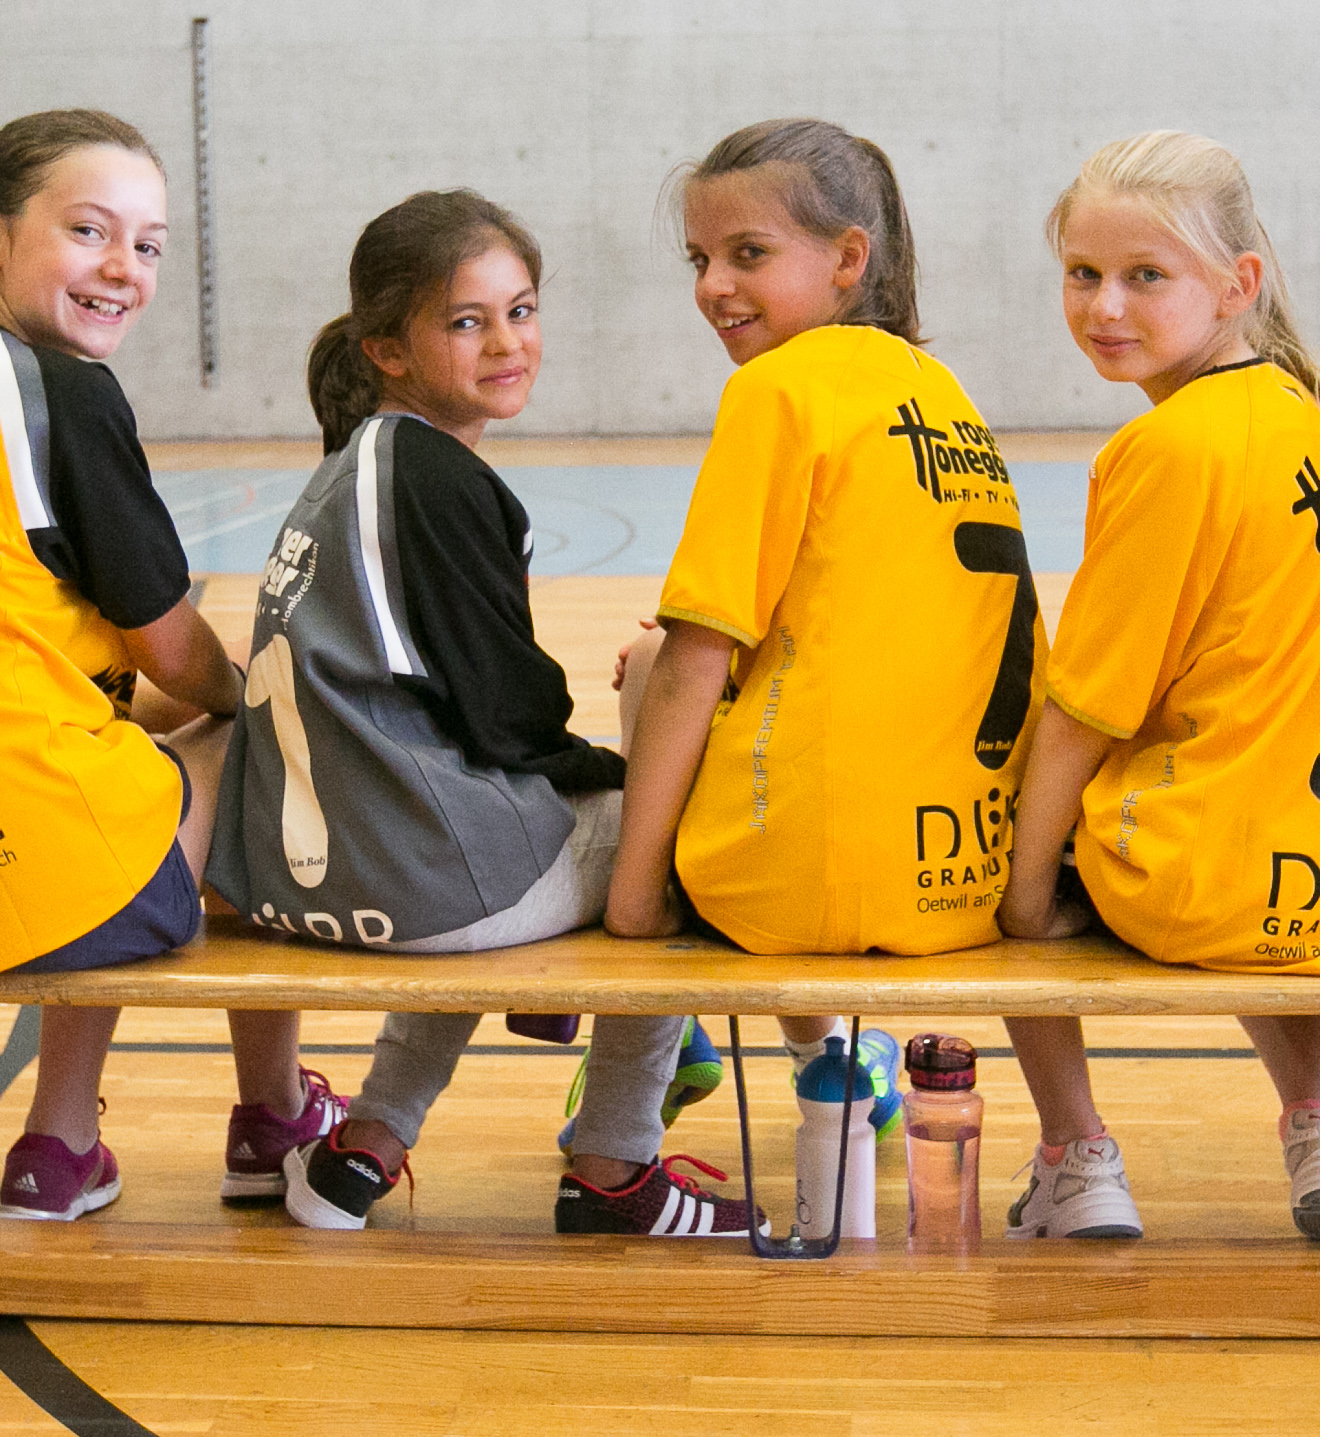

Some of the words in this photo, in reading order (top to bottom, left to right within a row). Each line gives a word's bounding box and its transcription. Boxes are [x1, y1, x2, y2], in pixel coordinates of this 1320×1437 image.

[986, 490, 999, 503] TV
[953, 521, 1039, 770] 7
[245, 634, 329, 888] 1
[306, 856, 326, 867] Bob
[917, 893, 968, 914] Oetwil
[973, 892, 995, 908] am
[1255, 941, 1307, 959] Oetwil
[346, 1158, 381, 1184] adidas
